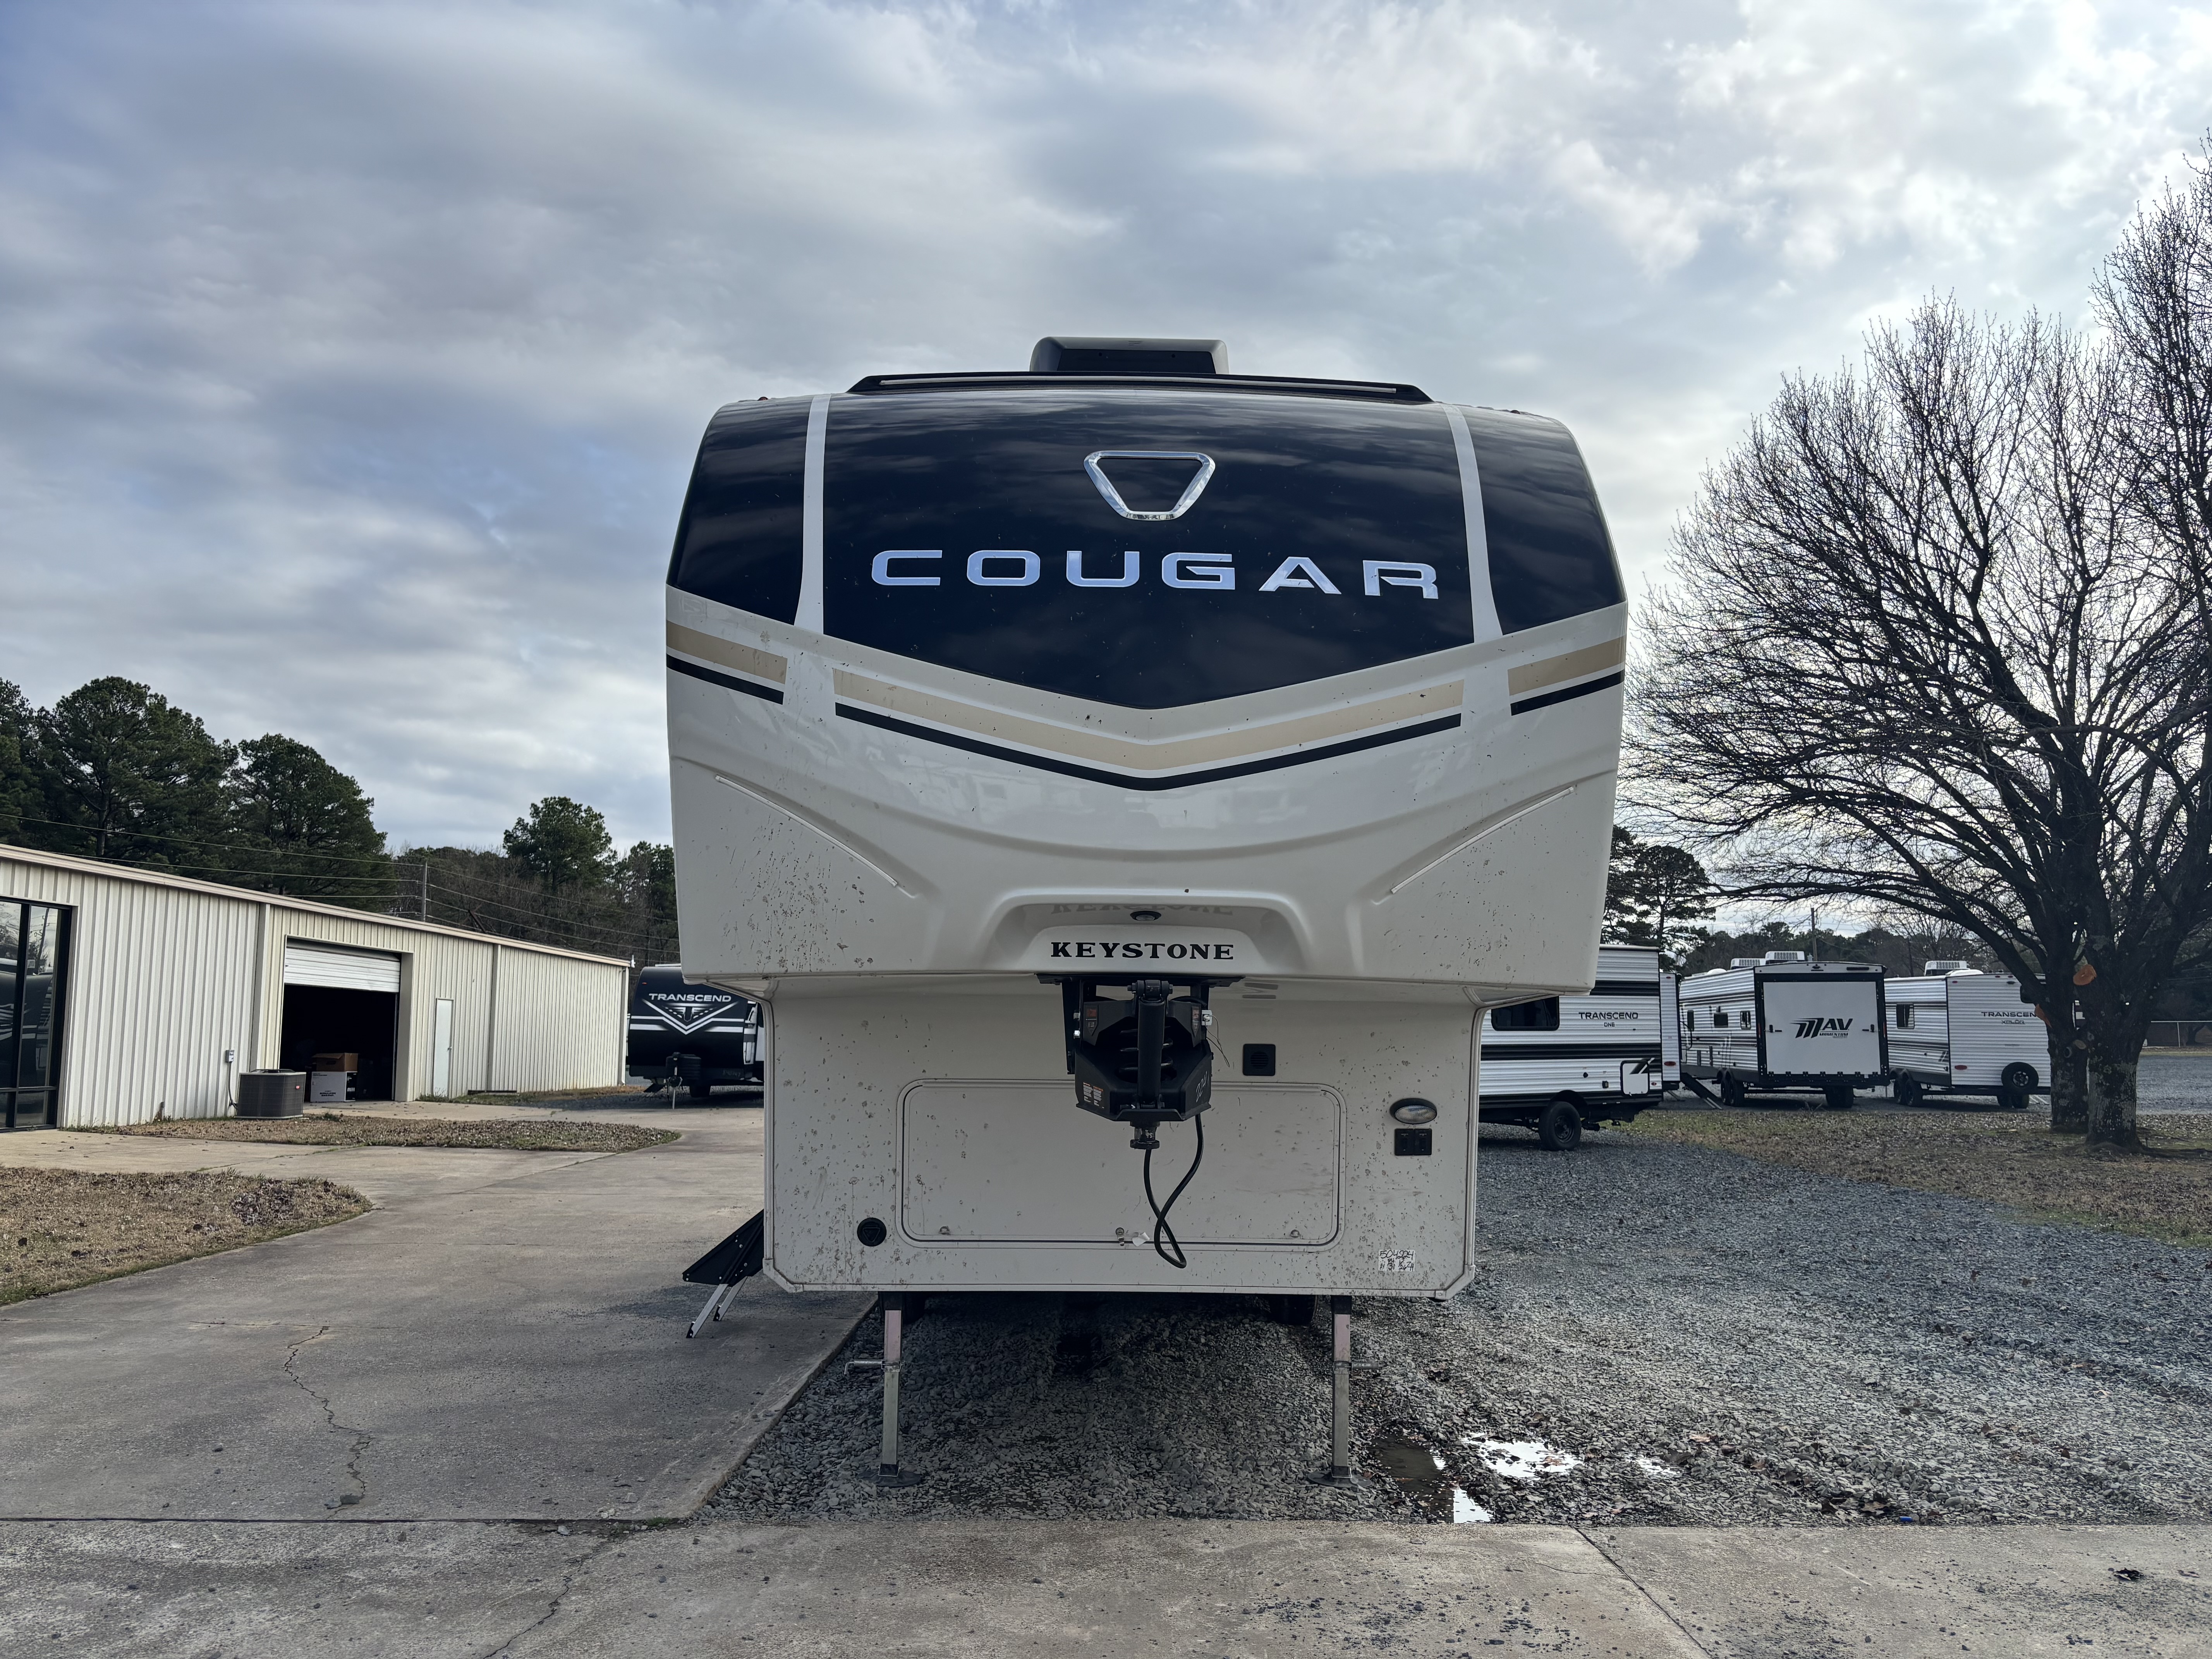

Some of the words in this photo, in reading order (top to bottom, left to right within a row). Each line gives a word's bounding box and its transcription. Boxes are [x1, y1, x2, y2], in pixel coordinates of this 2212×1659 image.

[871, 550, 1439, 599] COUGAR
[1051, 942, 1234, 960] KEYSTONE
[649, 993, 732, 1002] TRANSCEND
[1379, 1250, 1414, 1261] 504224
